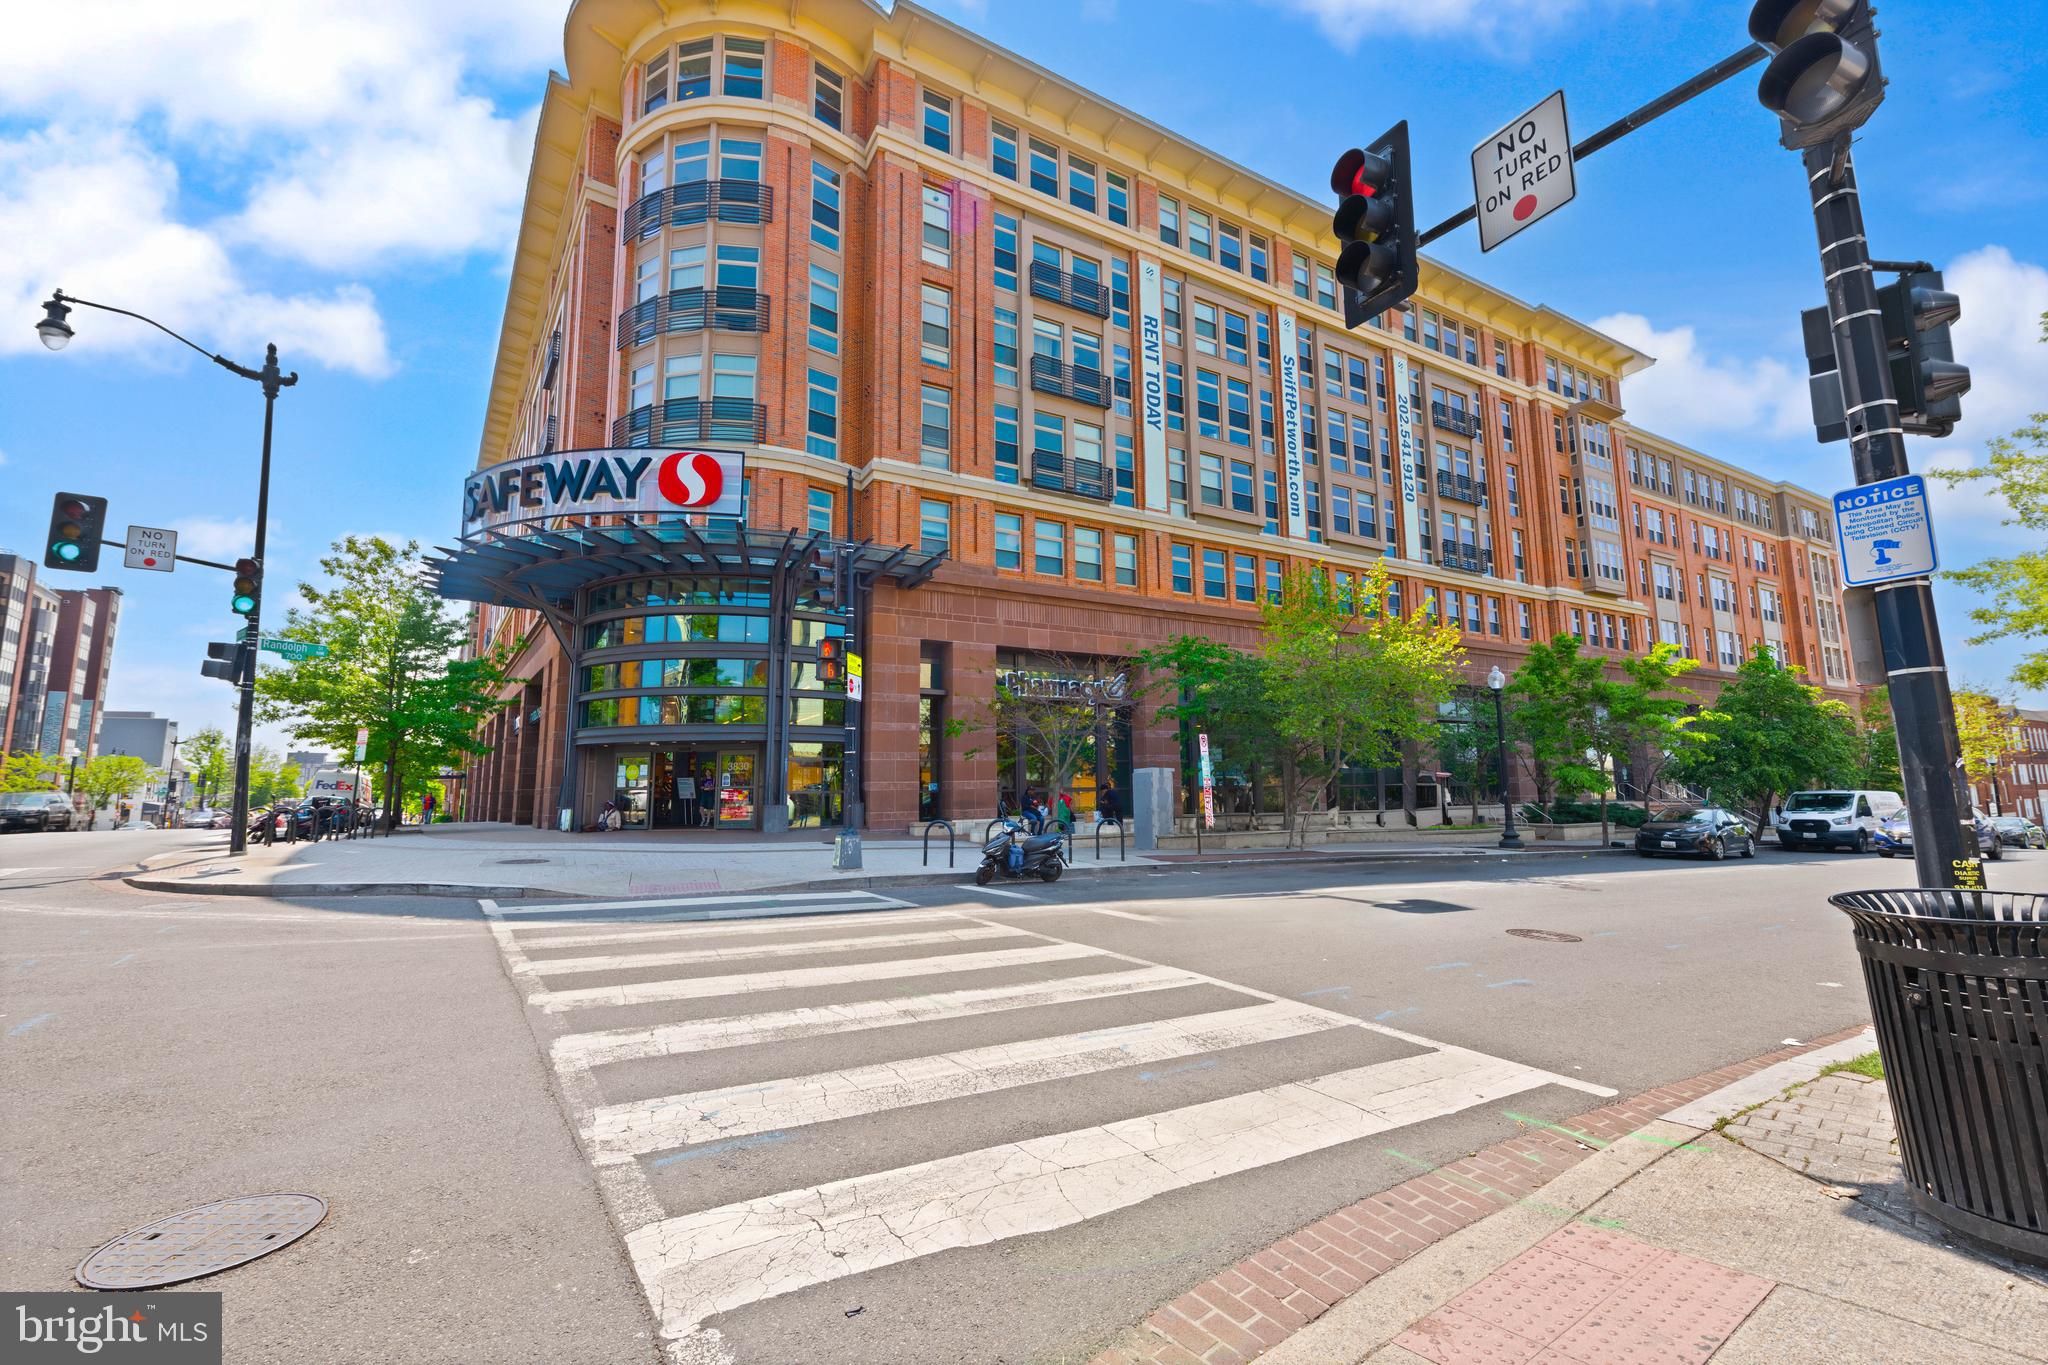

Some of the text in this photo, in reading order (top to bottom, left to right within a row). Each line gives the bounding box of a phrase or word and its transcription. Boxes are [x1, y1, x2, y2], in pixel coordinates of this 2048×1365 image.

[1497, 121, 1536, 160] NO
[1494, 138, 1547, 184] TURN
[1486, 155, 1562, 213] ON RED
[1143, 314, 1162, 431] RENT TODAY
[1283, 354, 1301, 517] SwiftPetworth.com
[1397, 394, 1415, 503] 202.541.9120
[466, 456, 653, 522] SAFEWAY
[1839, 484, 1920, 510] NOTICE
[1849, 512, 1887, 524] Monitored
[1865, 506, 1882, 515] Area
[1885, 503, 1901, 512] May
[1844, 517, 1924, 537] Using Closed Circuit
[1845, 511, 1921, 531] Metropolitan Police
[142, 530, 163, 540] NO
[1851, 523, 1920, 541] Television (CCTV)
[137, 540, 166, 549] TURN
[150, 550, 171, 558] RED
[263, 640, 308, 653] Randolph
[1004, 670, 1105, 706] Pharmacy
[315, 780, 353, 791] FedEx
